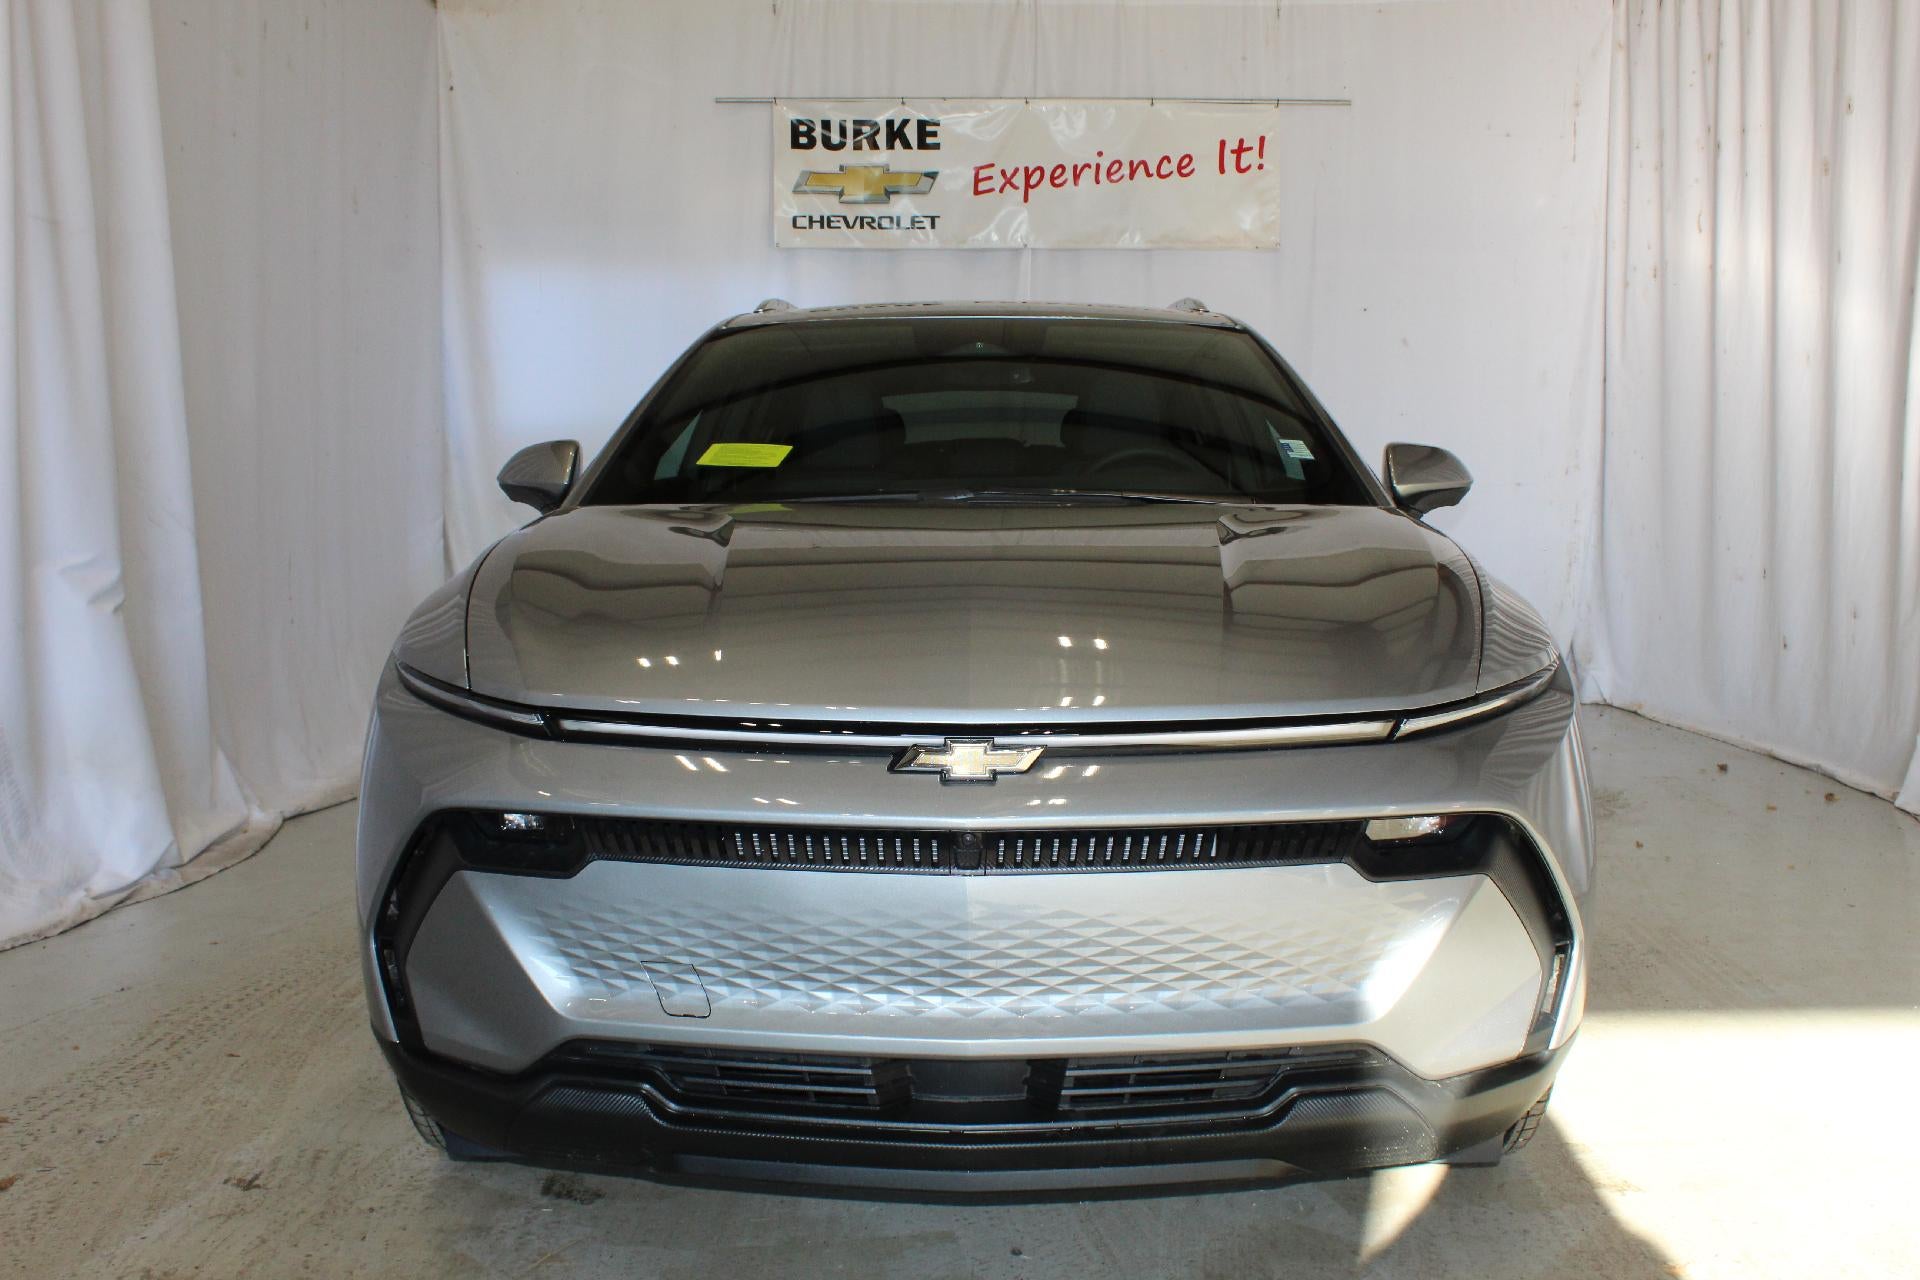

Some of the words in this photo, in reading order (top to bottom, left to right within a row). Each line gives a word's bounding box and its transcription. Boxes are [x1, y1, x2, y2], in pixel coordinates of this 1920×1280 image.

[790, 118, 941, 151] BURKE
[972, 151, 1195, 202] Experience
[1218, 136, 1266, 175] It!
[792, 215, 940, 230] CHEVROLET
